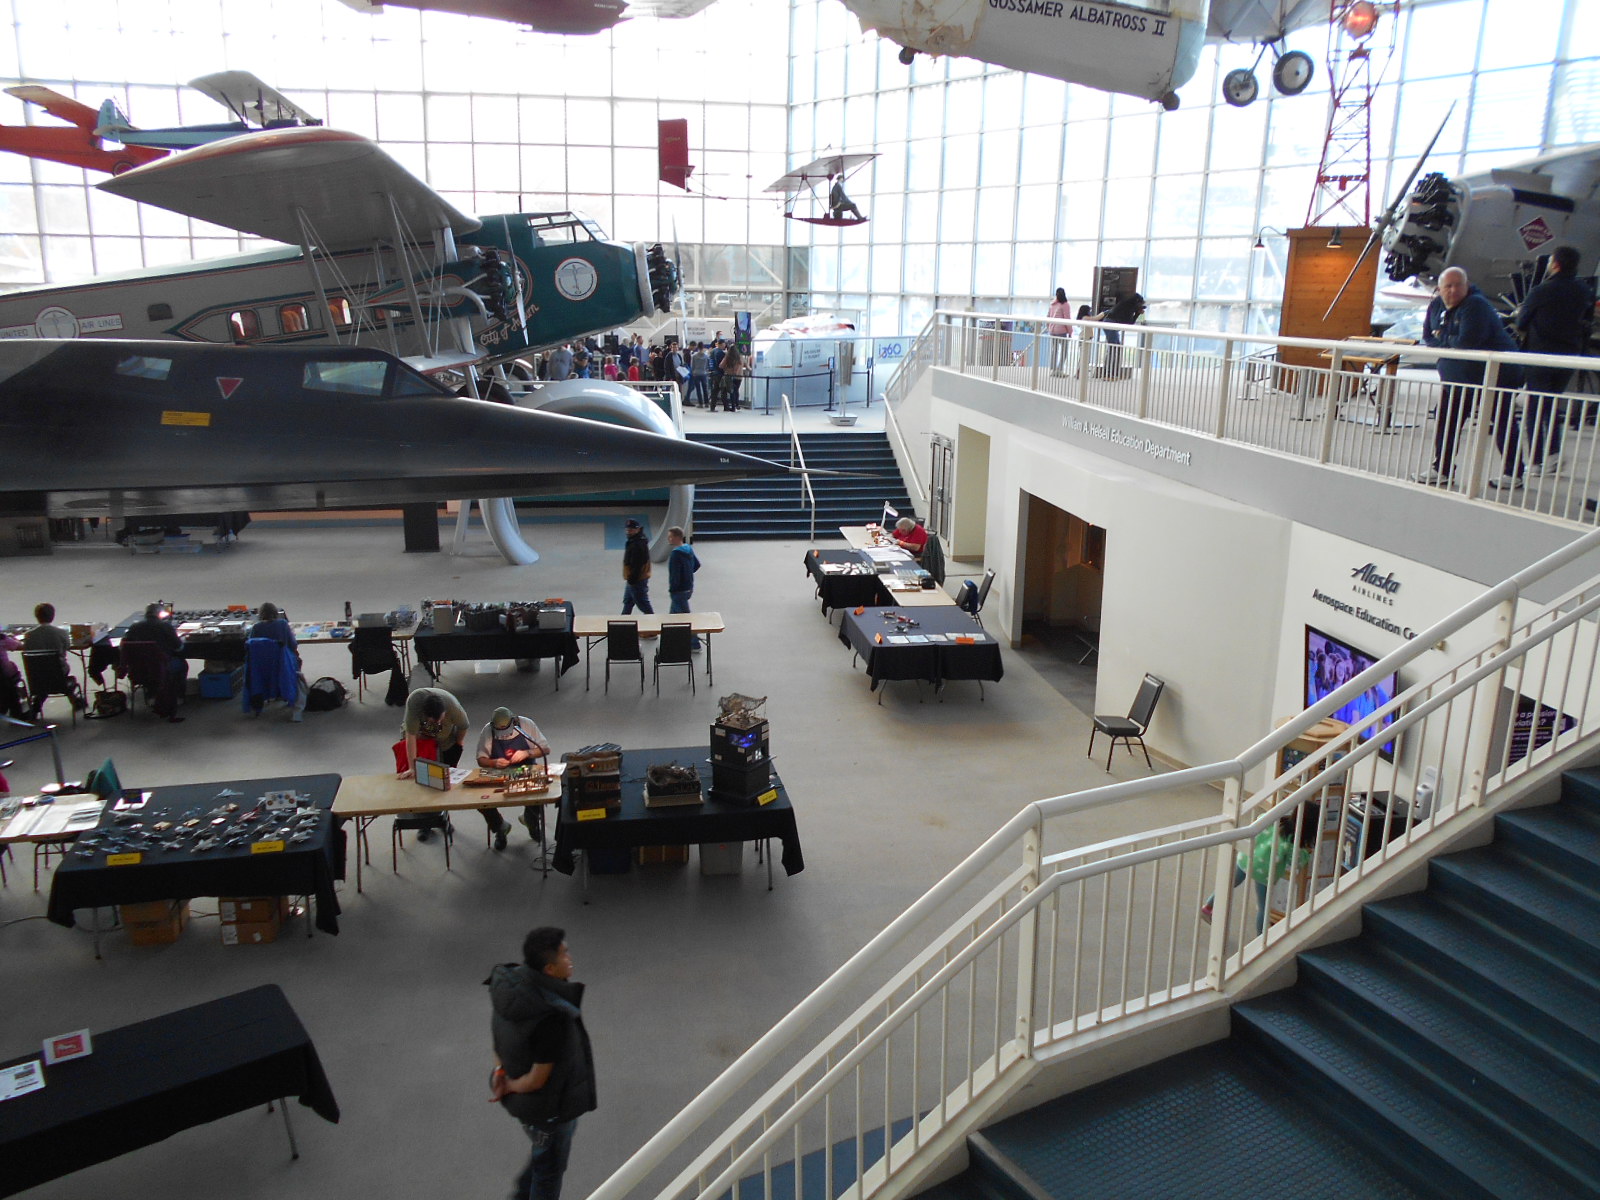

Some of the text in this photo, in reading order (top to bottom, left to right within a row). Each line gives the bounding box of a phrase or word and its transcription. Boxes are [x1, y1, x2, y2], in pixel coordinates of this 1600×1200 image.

[989, 0, 1063, 18] GOSSAMER
[1069, 6, 1148, 33] ALBATROSS
[81, 320, 95, 329] AIR
[98, 318, 121, 328] LINES
[1062, 415, 1083, 432] William
[1111, 427, 1144, 452] Education
[1144, 439, 1192, 466] Department
[1350, 562, 1401, 594] Alaska
[1352, 585, 1394, 606] AIRLINES
[1312, 588, 1354, 616] Aerospace
[1355, 606, 1401, 636] Education
